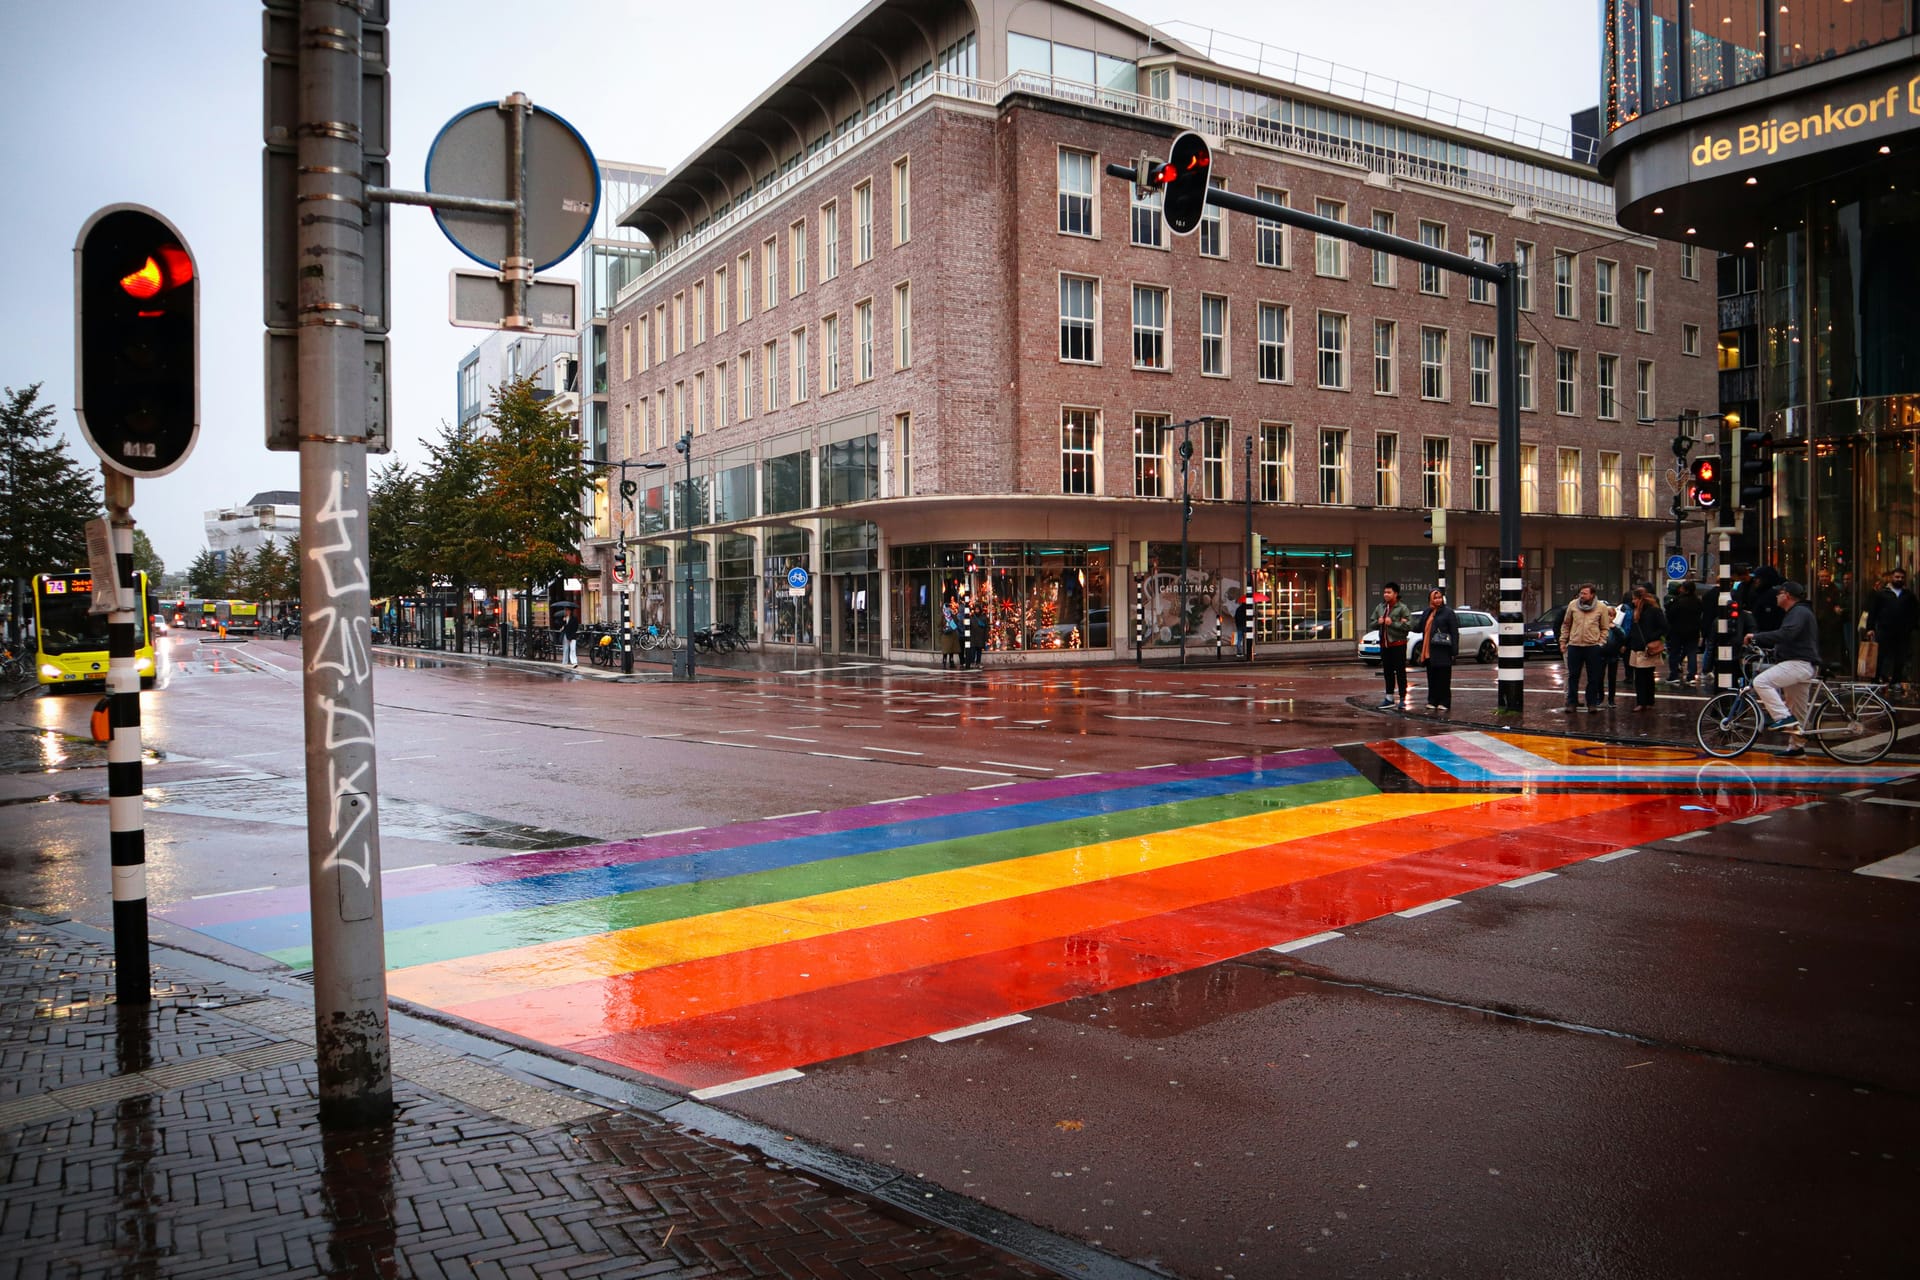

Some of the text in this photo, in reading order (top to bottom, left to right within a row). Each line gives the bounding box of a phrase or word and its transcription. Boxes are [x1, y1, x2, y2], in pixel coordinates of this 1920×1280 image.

[1692, 86, 1899, 166] de Bijenkorf
[49, 582, 64, 592] 74
[1400, 583, 1433, 591] RISTMAS
